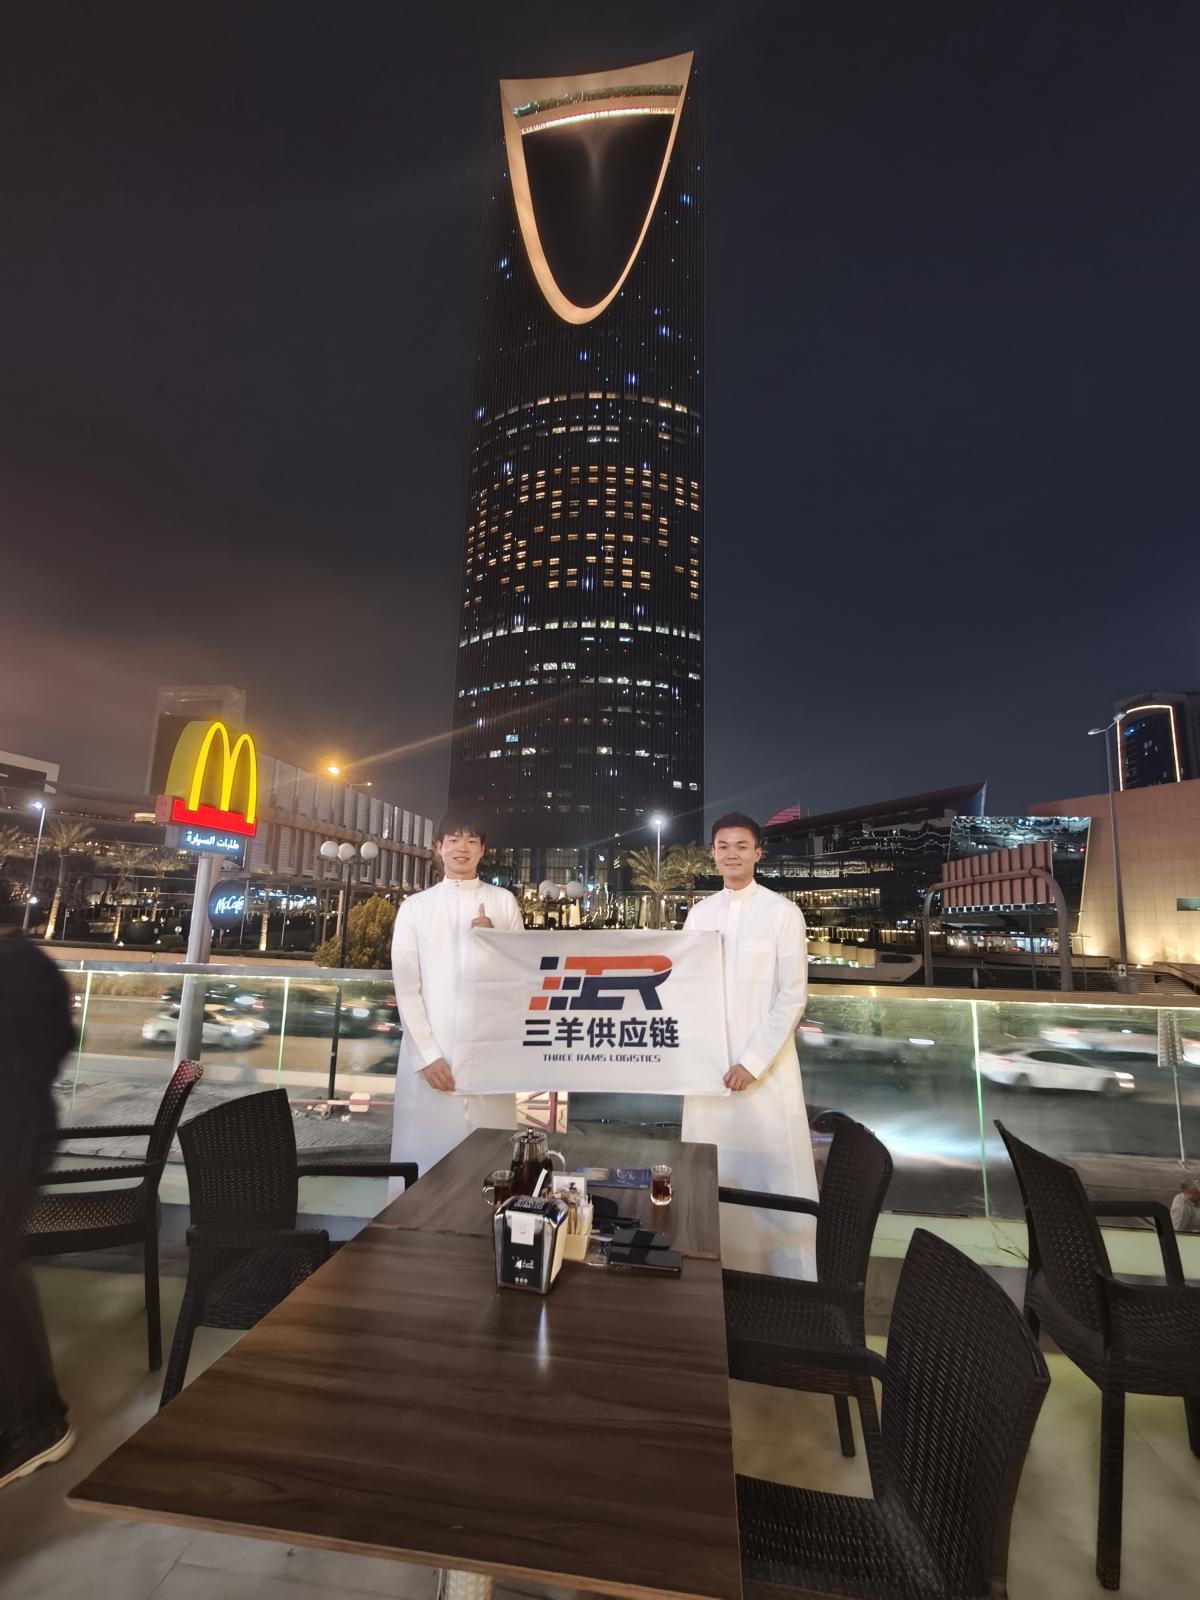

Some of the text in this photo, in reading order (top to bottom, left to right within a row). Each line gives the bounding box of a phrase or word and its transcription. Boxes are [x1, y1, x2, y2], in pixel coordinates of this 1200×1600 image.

[522, 1017, 680, 1048] 三羊供应链
[543, 1053, 661, 1063] THREE RAMS LOGISTICS
